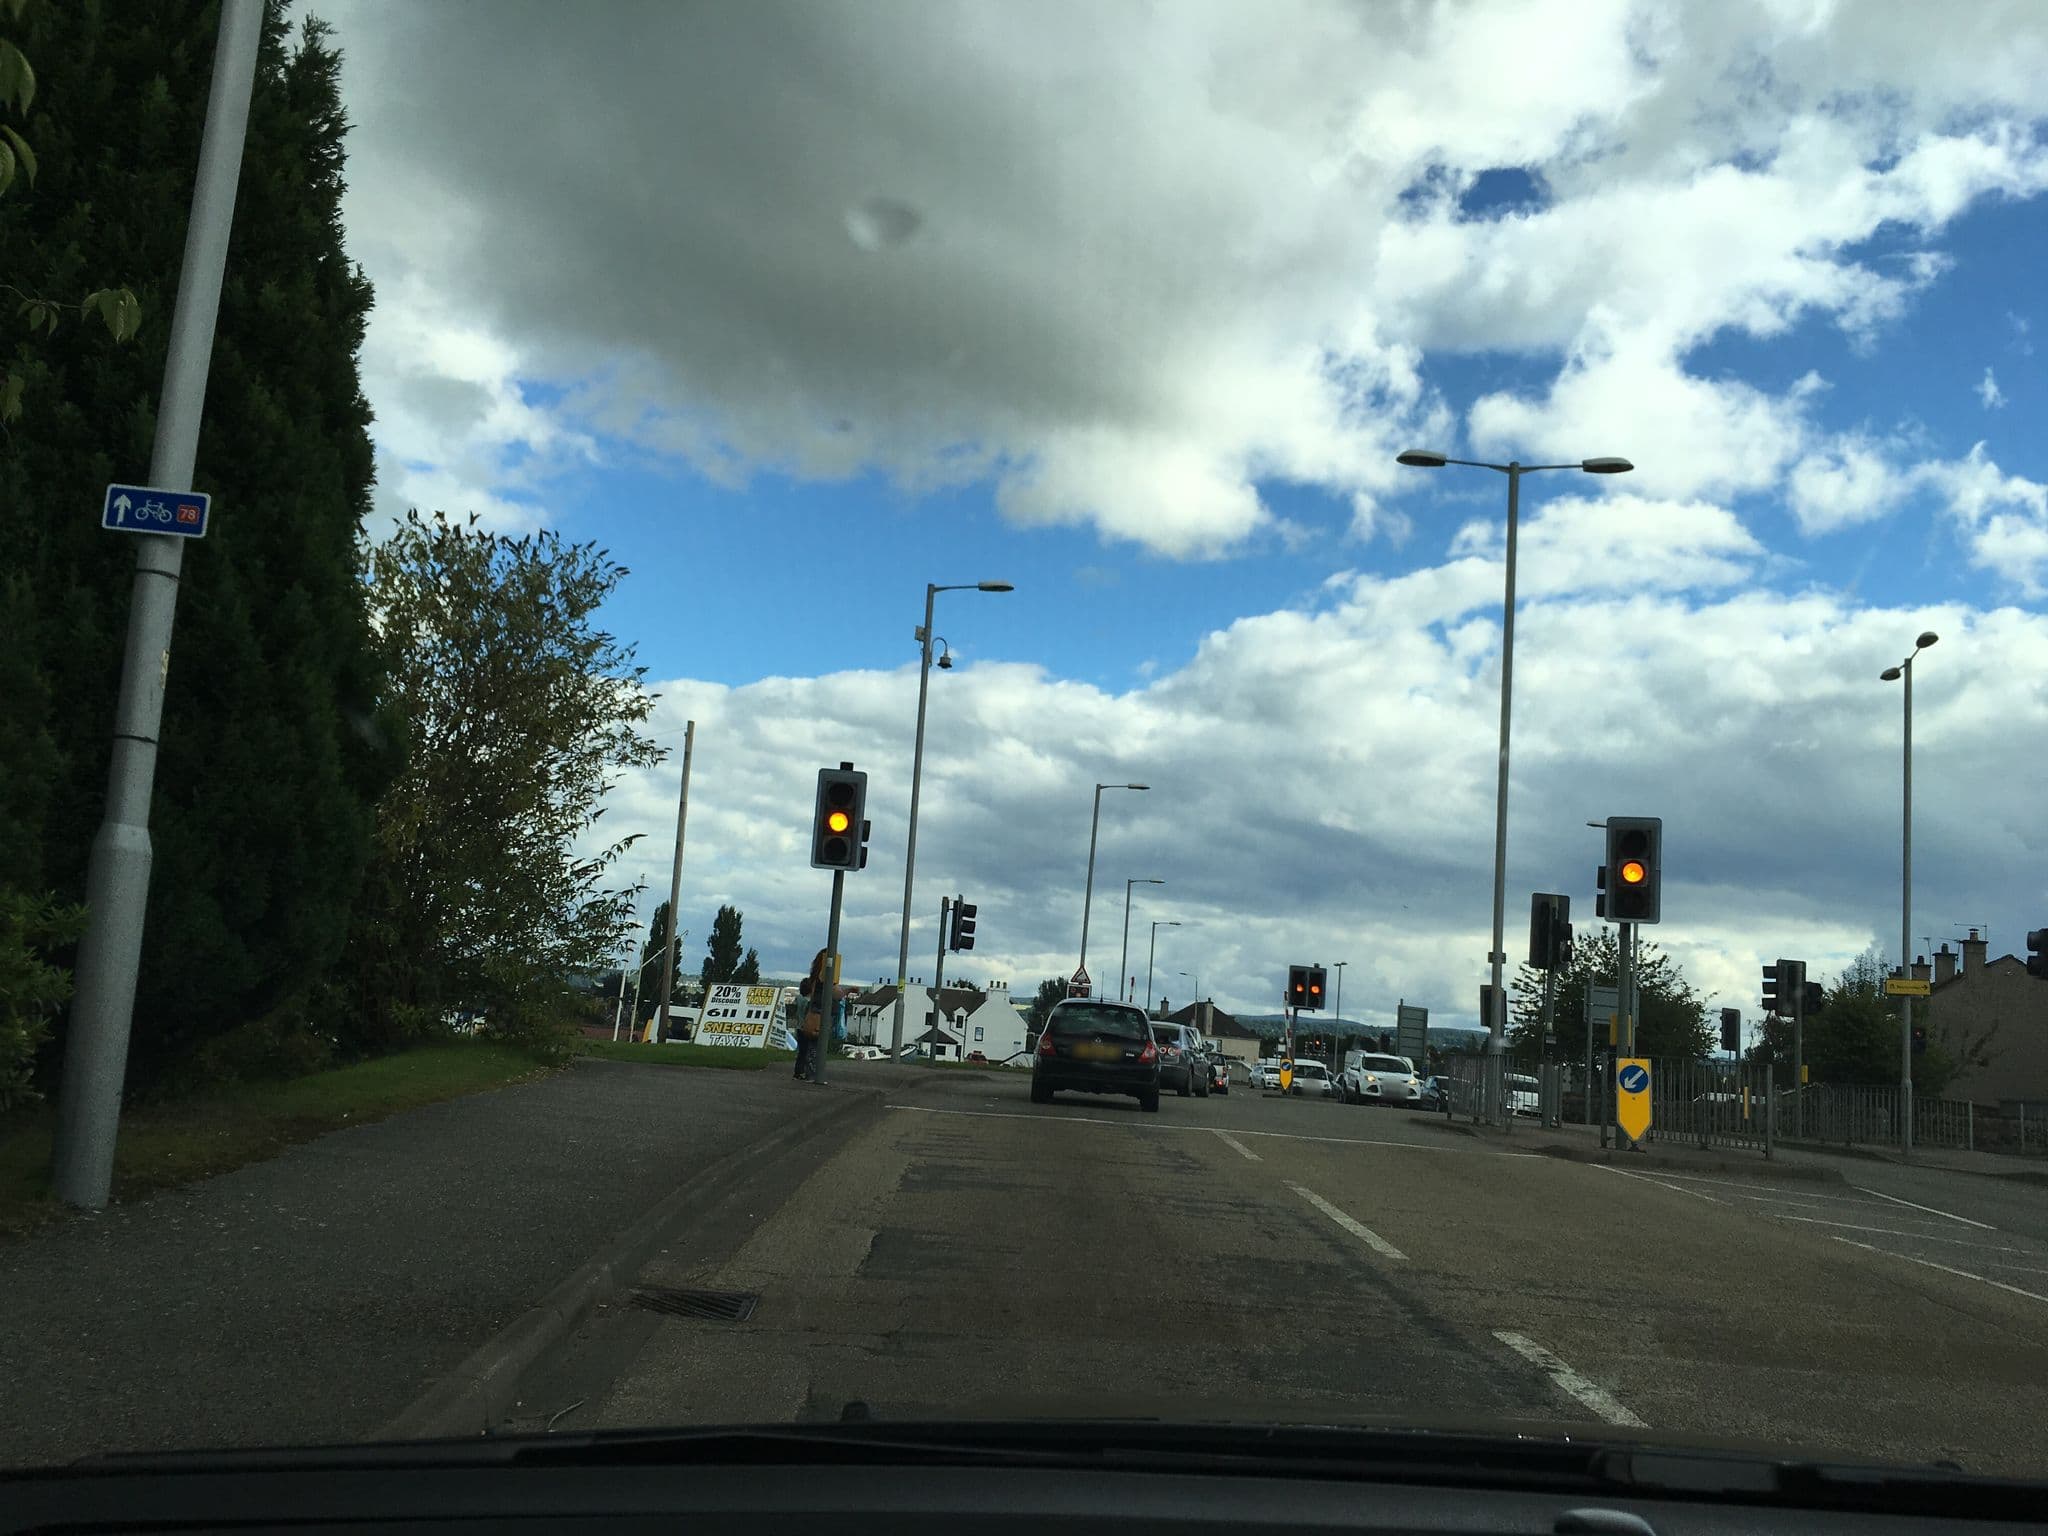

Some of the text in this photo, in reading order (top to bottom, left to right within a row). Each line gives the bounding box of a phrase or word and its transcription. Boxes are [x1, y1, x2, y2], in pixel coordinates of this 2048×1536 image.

[180, 509, 196, 520] 78
[714, 986, 742, 998] 20%
[748, 988, 775, 997] FREE
[747, 996, 772, 1005] TAXI
[707, 1008, 770, 1019] 611 111
[703, 1022, 765, 1036] SNECKIE
[709, 1035, 751, 1047] TAXIS
